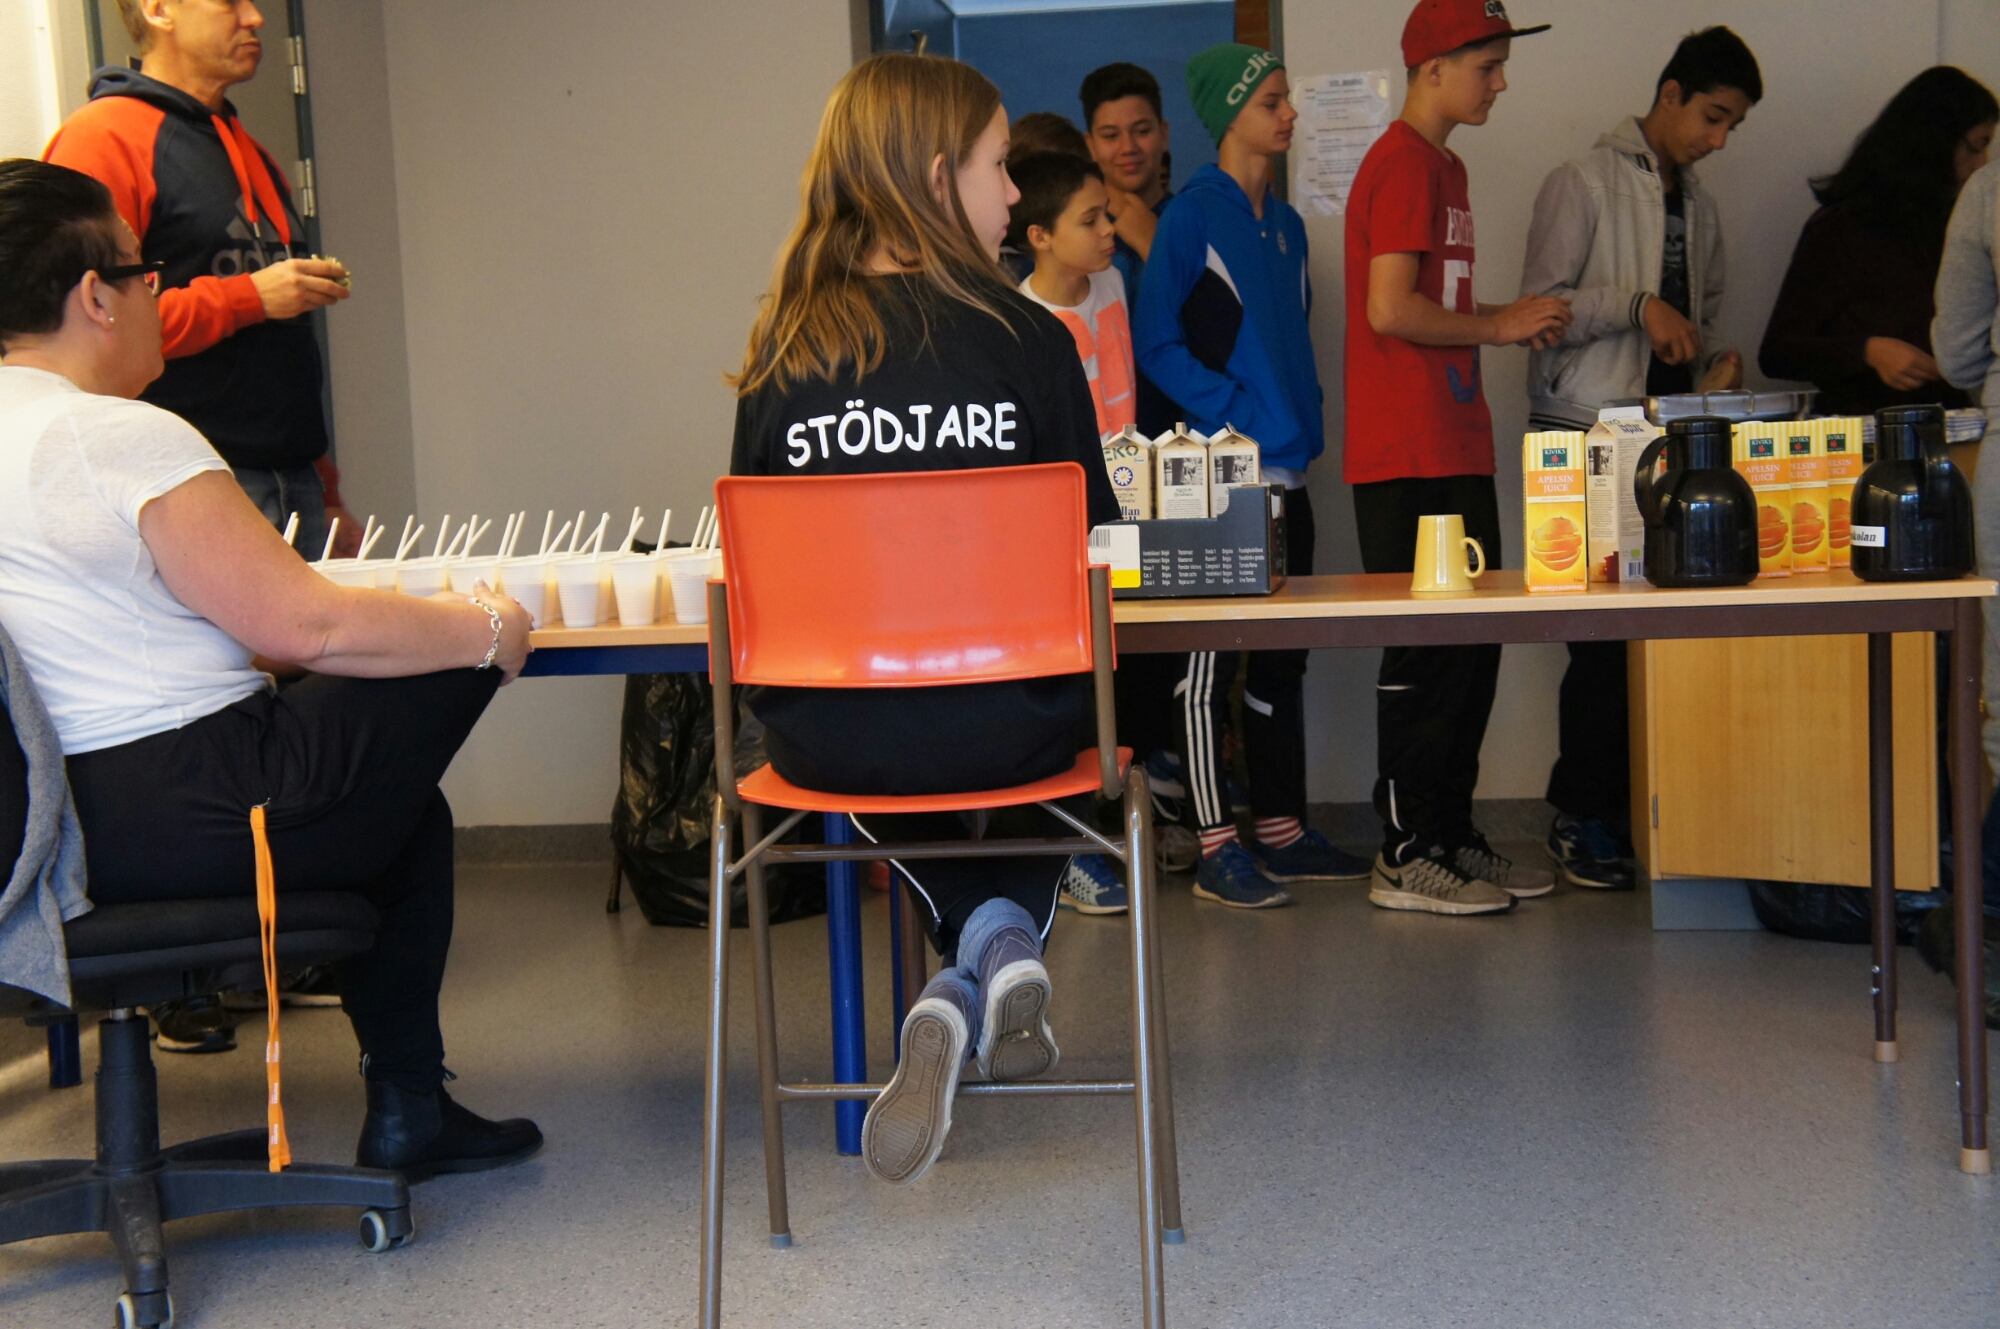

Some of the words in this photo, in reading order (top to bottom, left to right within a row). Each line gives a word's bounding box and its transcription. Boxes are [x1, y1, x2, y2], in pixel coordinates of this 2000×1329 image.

[786, 398, 1017, 468] STÖDJARE
[1828, 459, 1853, 467] ELSIN
[1745, 464, 1781, 473] APELSIN
[1537, 475, 1574, 484] APELSIN
[1752, 473, 1776, 482] JUICE
[1544, 484, 1569, 494] JUICE
[1121, 506, 1140, 516] llan
